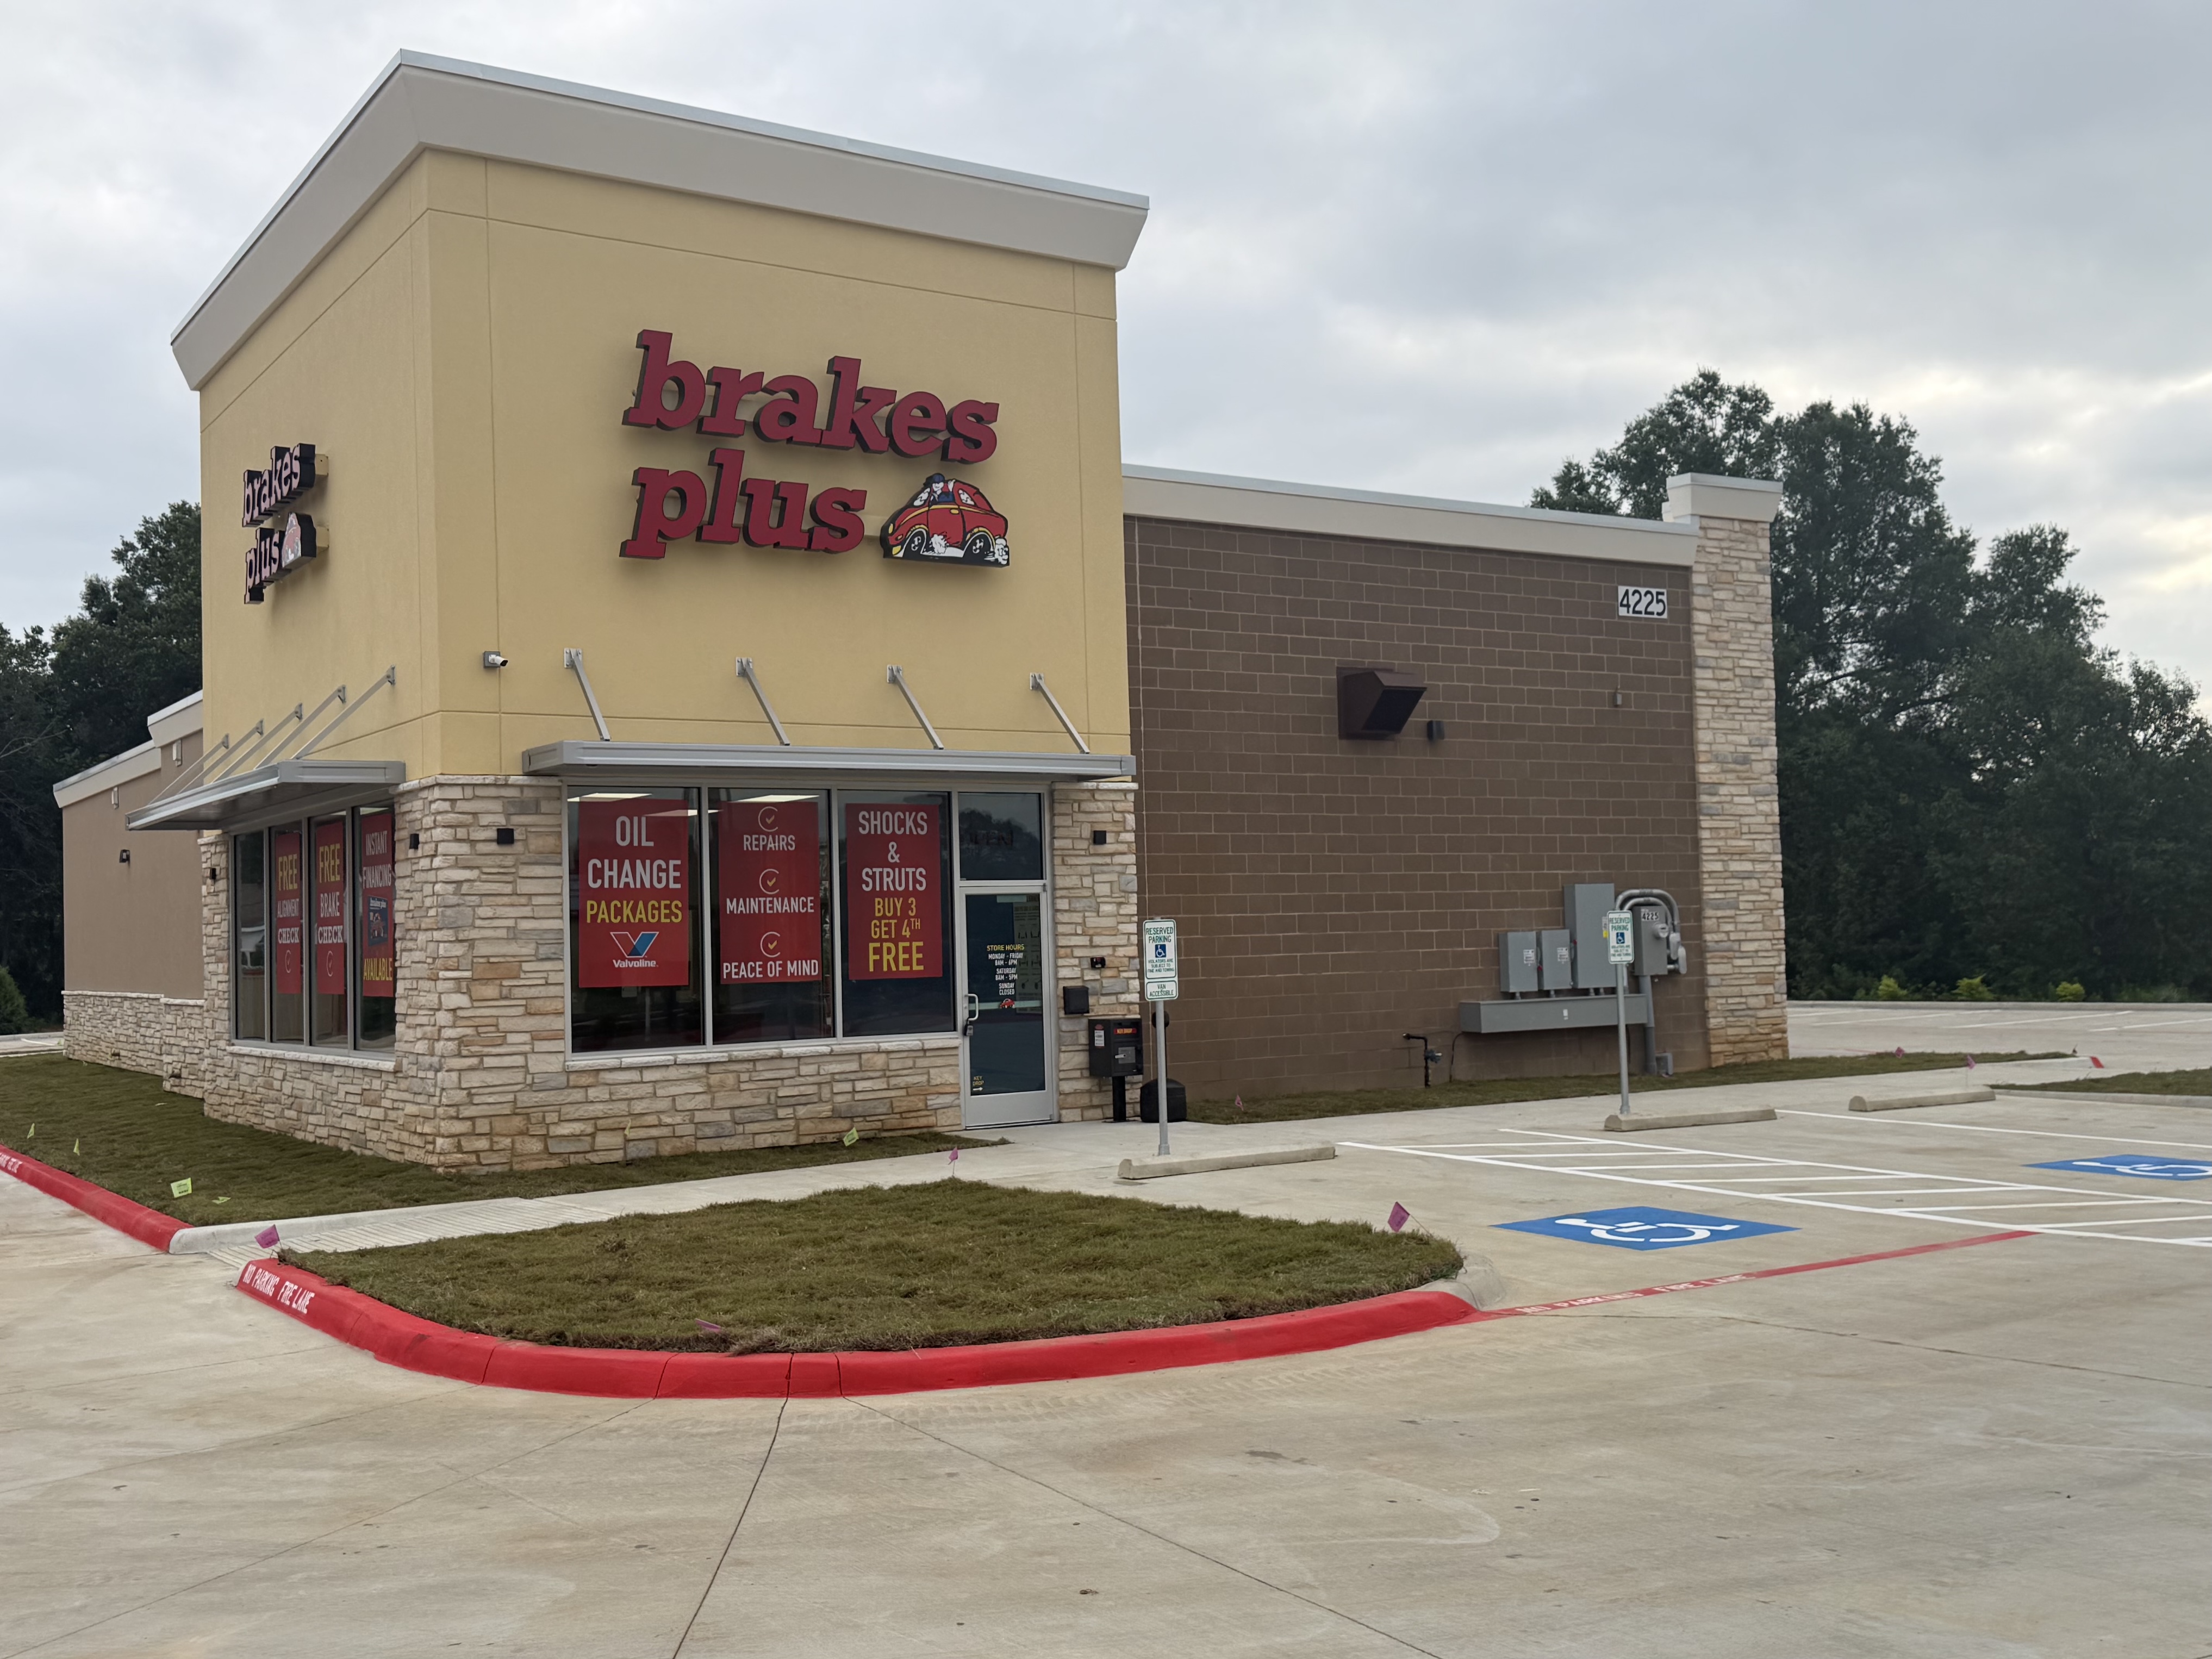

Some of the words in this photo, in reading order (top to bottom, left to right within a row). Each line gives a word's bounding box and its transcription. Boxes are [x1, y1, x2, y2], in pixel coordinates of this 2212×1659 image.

[622, 329, 999, 464] brakes
[242, 443, 303, 527] brakes
[619, 448, 867, 560] plus
[245, 528, 281, 604] plus
[1619, 589, 1666, 616] 4225
[616, 816, 654, 846] OIL
[858, 811, 928, 835] SHOCKS
[366, 830, 388, 856] INSTANT
[743, 835, 795, 851] REPAIRS
[888, 841, 900, 863] &
[278, 853, 298, 891] FREE
[319, 843, 340, 883] FREE
[588, 859, 681, 889] CHANGE
[363, 864, 392, 889] FINANCING
[862, 868, 926, 892] STRUTS
[277, 899, 299, 918] ALIGNMENT
[320, 891, 340, 918] BRAKE
[587, 900, 682, 923] PACKAGES
[726, 897, 814, 914] MAINTENANCE
[875, 898, 902, 917] BUY
[908, 897, 917, 916] 3
[1642, 912, 1659, 920] 4225
[278, 927, 299, 944] CHECK
[318, 925, 343, 944] CHECK
[871, 920, 898, 939] GET
[1146, 927, 1174, 935] RESERVED
[613, 959, 656, 968] Valvoline
[869, 941, 924, 972] FREE
[364, 958, 392, 981] AVAILABLE
[723, 962, 764, 979] PEACE
[767, 961, 783, 977] OF
[787, 959, 819, 976] MIND
[242, 1264, 256, 1284] NO
[251, 1268, 280, 1296] PARKING
[277, 1281, 298, 1305] FIRE
[292, 1288, 315, 1314] LANE
[1553, 1292, 1644, 1307] PARKING
[1652, 1282, 1704, 1292] FIRE
[1700, 1274, 1756, 1285] LANE
